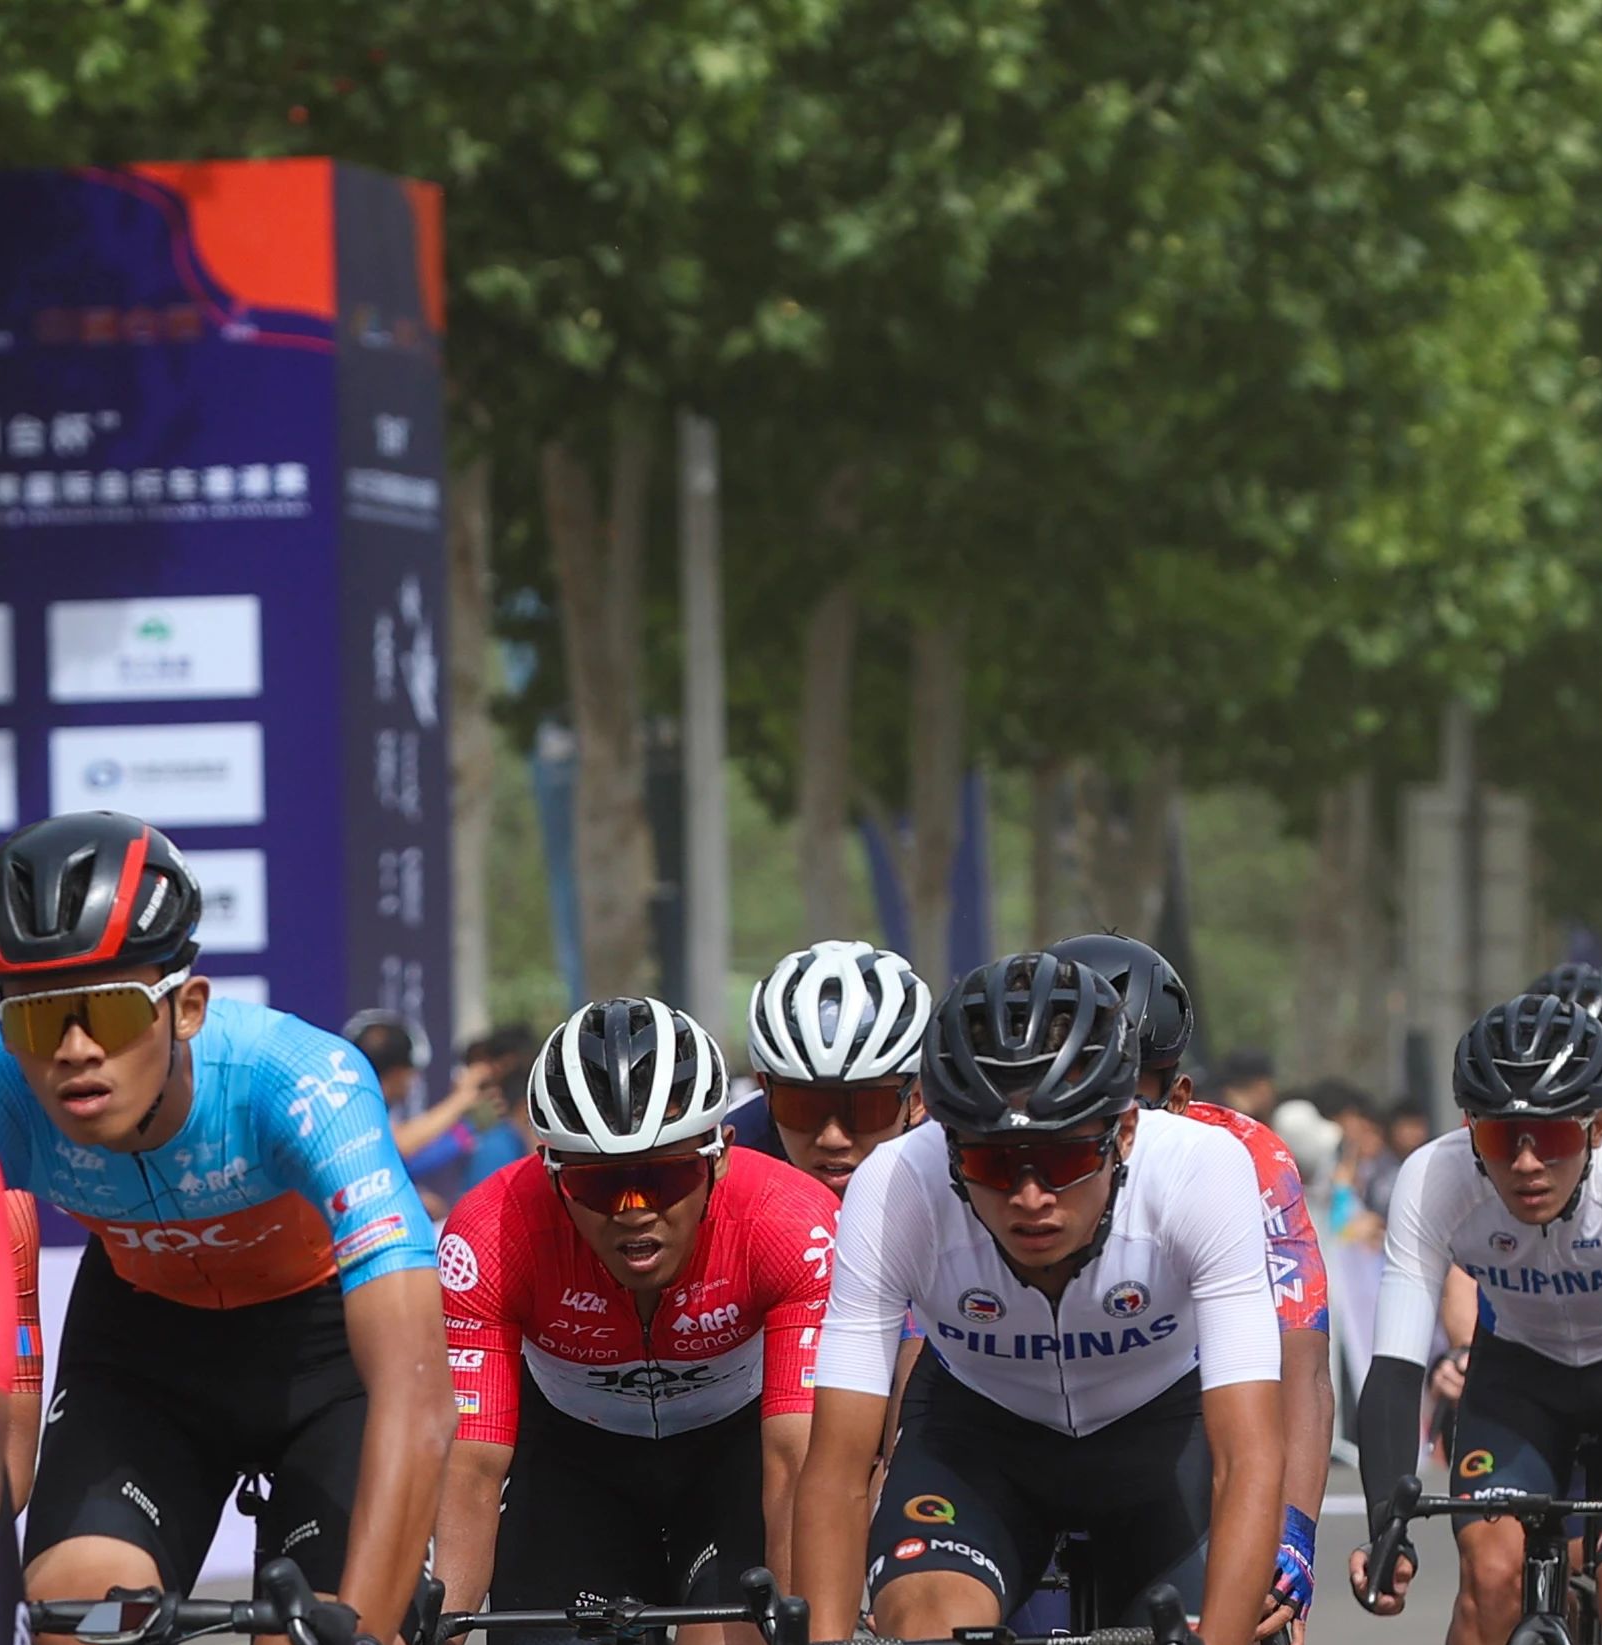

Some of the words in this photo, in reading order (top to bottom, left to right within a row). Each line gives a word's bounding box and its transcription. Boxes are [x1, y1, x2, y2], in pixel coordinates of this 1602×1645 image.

[560, 1288, 607, 1314] LAZER
[698, 1303, 741, 1333] RFP
[549, 1319, 616, 1339] PYC
[937, 1313, 1179, 1361] PILIPINAS
[559, 1343, 619, 1360] bryton
[579, 1590, 608, 1604] COM
[575, 1610, 604, 1618] GARMIN
